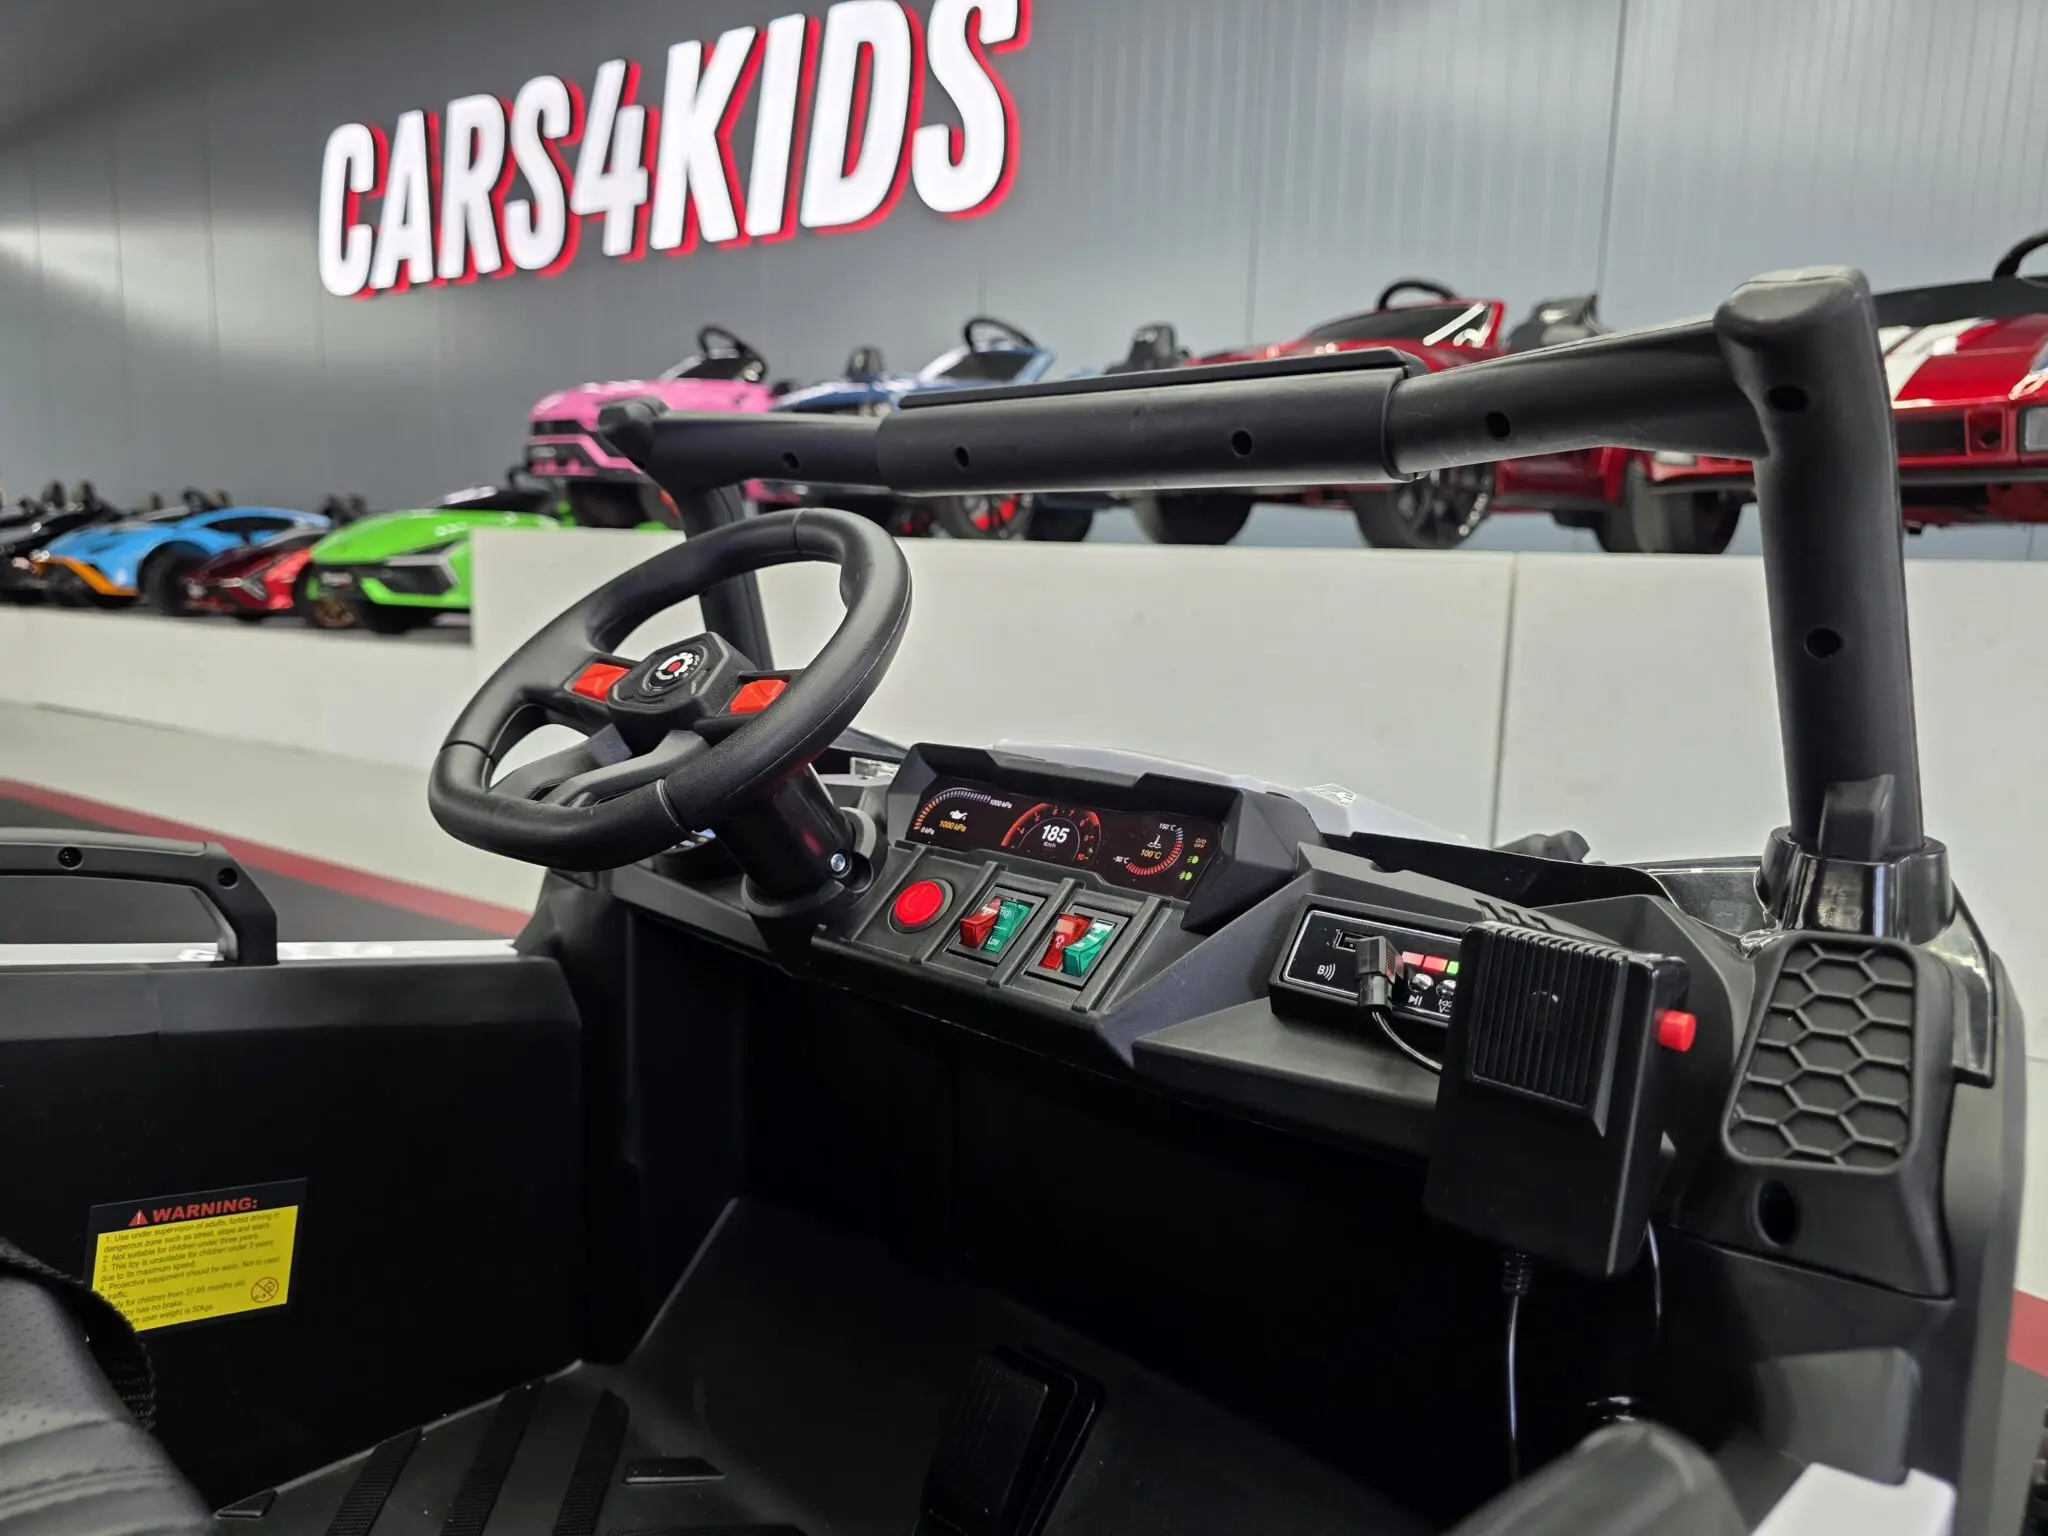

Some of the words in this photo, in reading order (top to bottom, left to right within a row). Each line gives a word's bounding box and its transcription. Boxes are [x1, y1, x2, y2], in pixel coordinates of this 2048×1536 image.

[318, 0, 1028, 297] CARS4KIDS
[939, 820, 954, 830] 1000
[1041, 825, 1070, 843] 185
[152, 1197, 258, 1222] WARNING:
[114, 1233, 129, 1241] Use
[131, 1229, 152, 1239] under
[103, 1241, 142, 1252] dangerous
[112, 1252, 125, 1260] Not
[111, 1261, 127, 1270] This
[100, 1273, 114, 1282] due
